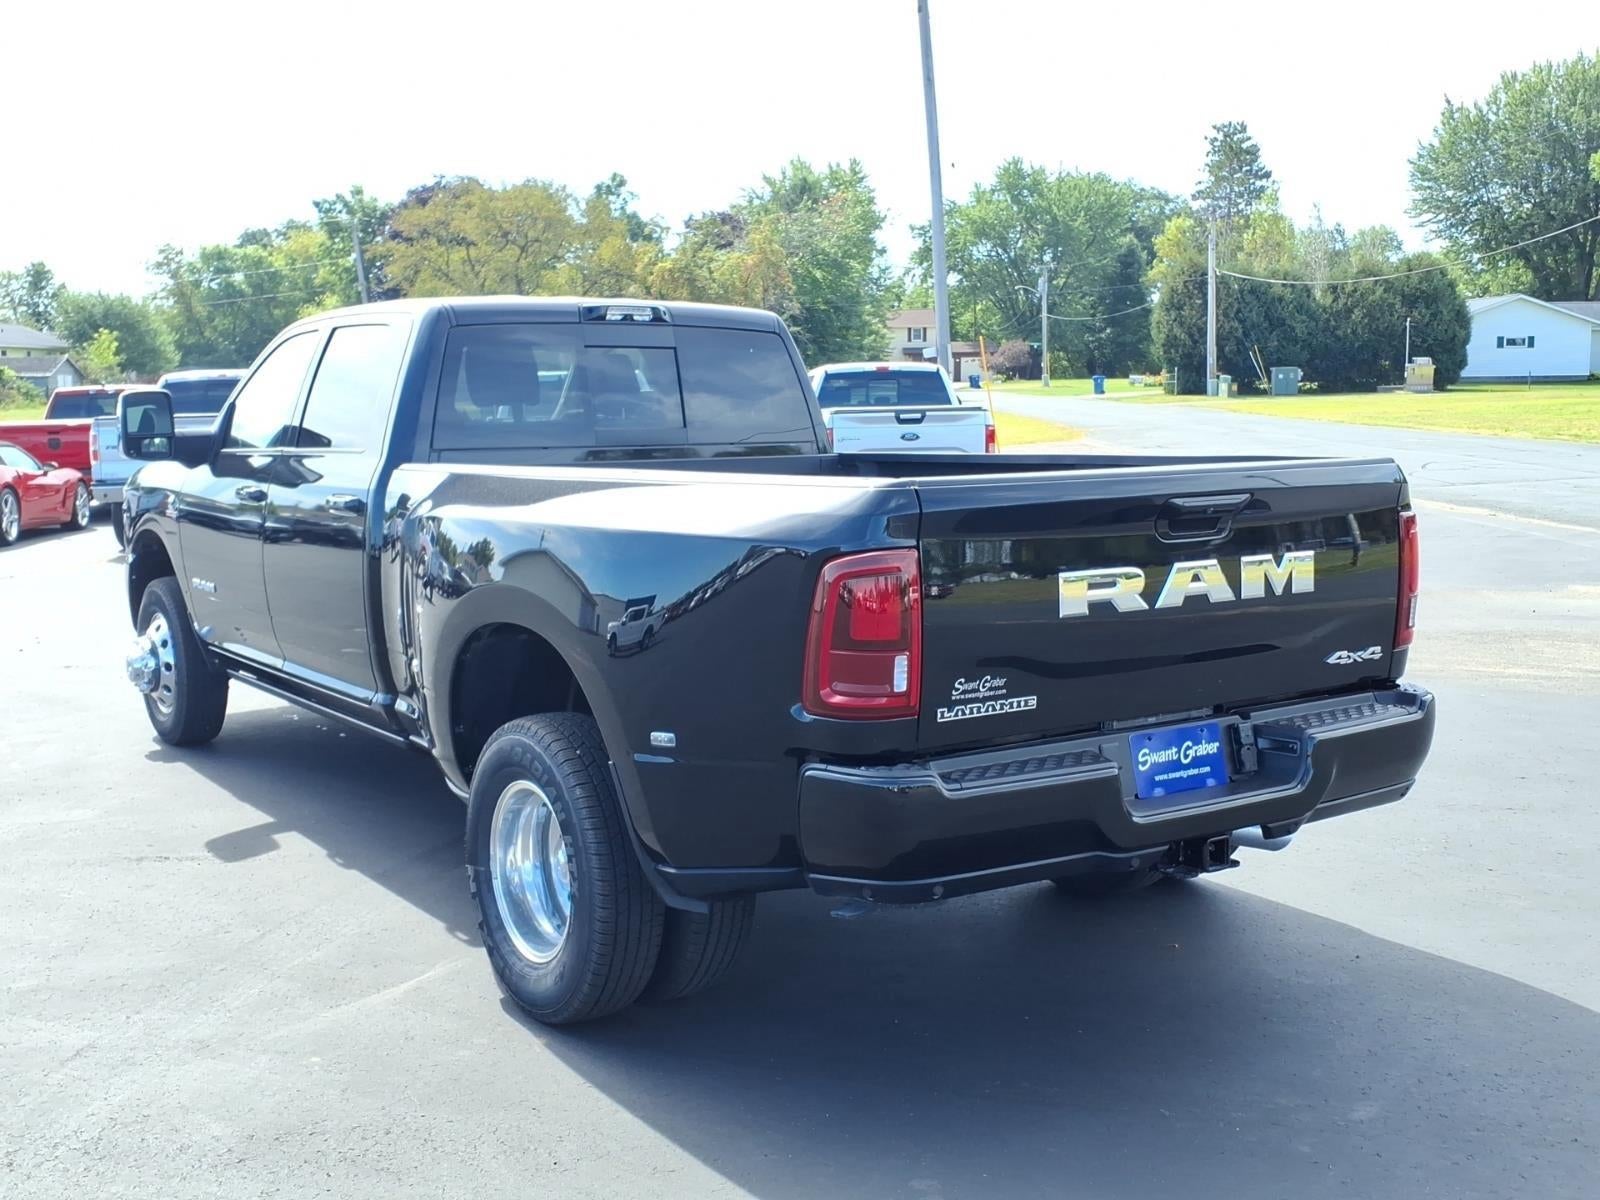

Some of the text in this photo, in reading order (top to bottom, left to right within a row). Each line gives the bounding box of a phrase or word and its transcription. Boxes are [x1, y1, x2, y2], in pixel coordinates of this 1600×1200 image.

[1059, 551, 1315, 618] RAM
[1325, 645, 1383, 664] 4x4
[951, 689, 1007, 701] www.swantgraber.com
[952, 675, 1007, 695] Swant Graber
[937, 696, 1037, 722] LARAMIE
[1138, 740, 1219, 771] Swant Graber
[1154, 766, 1211, 781] www.swantgraber.com
